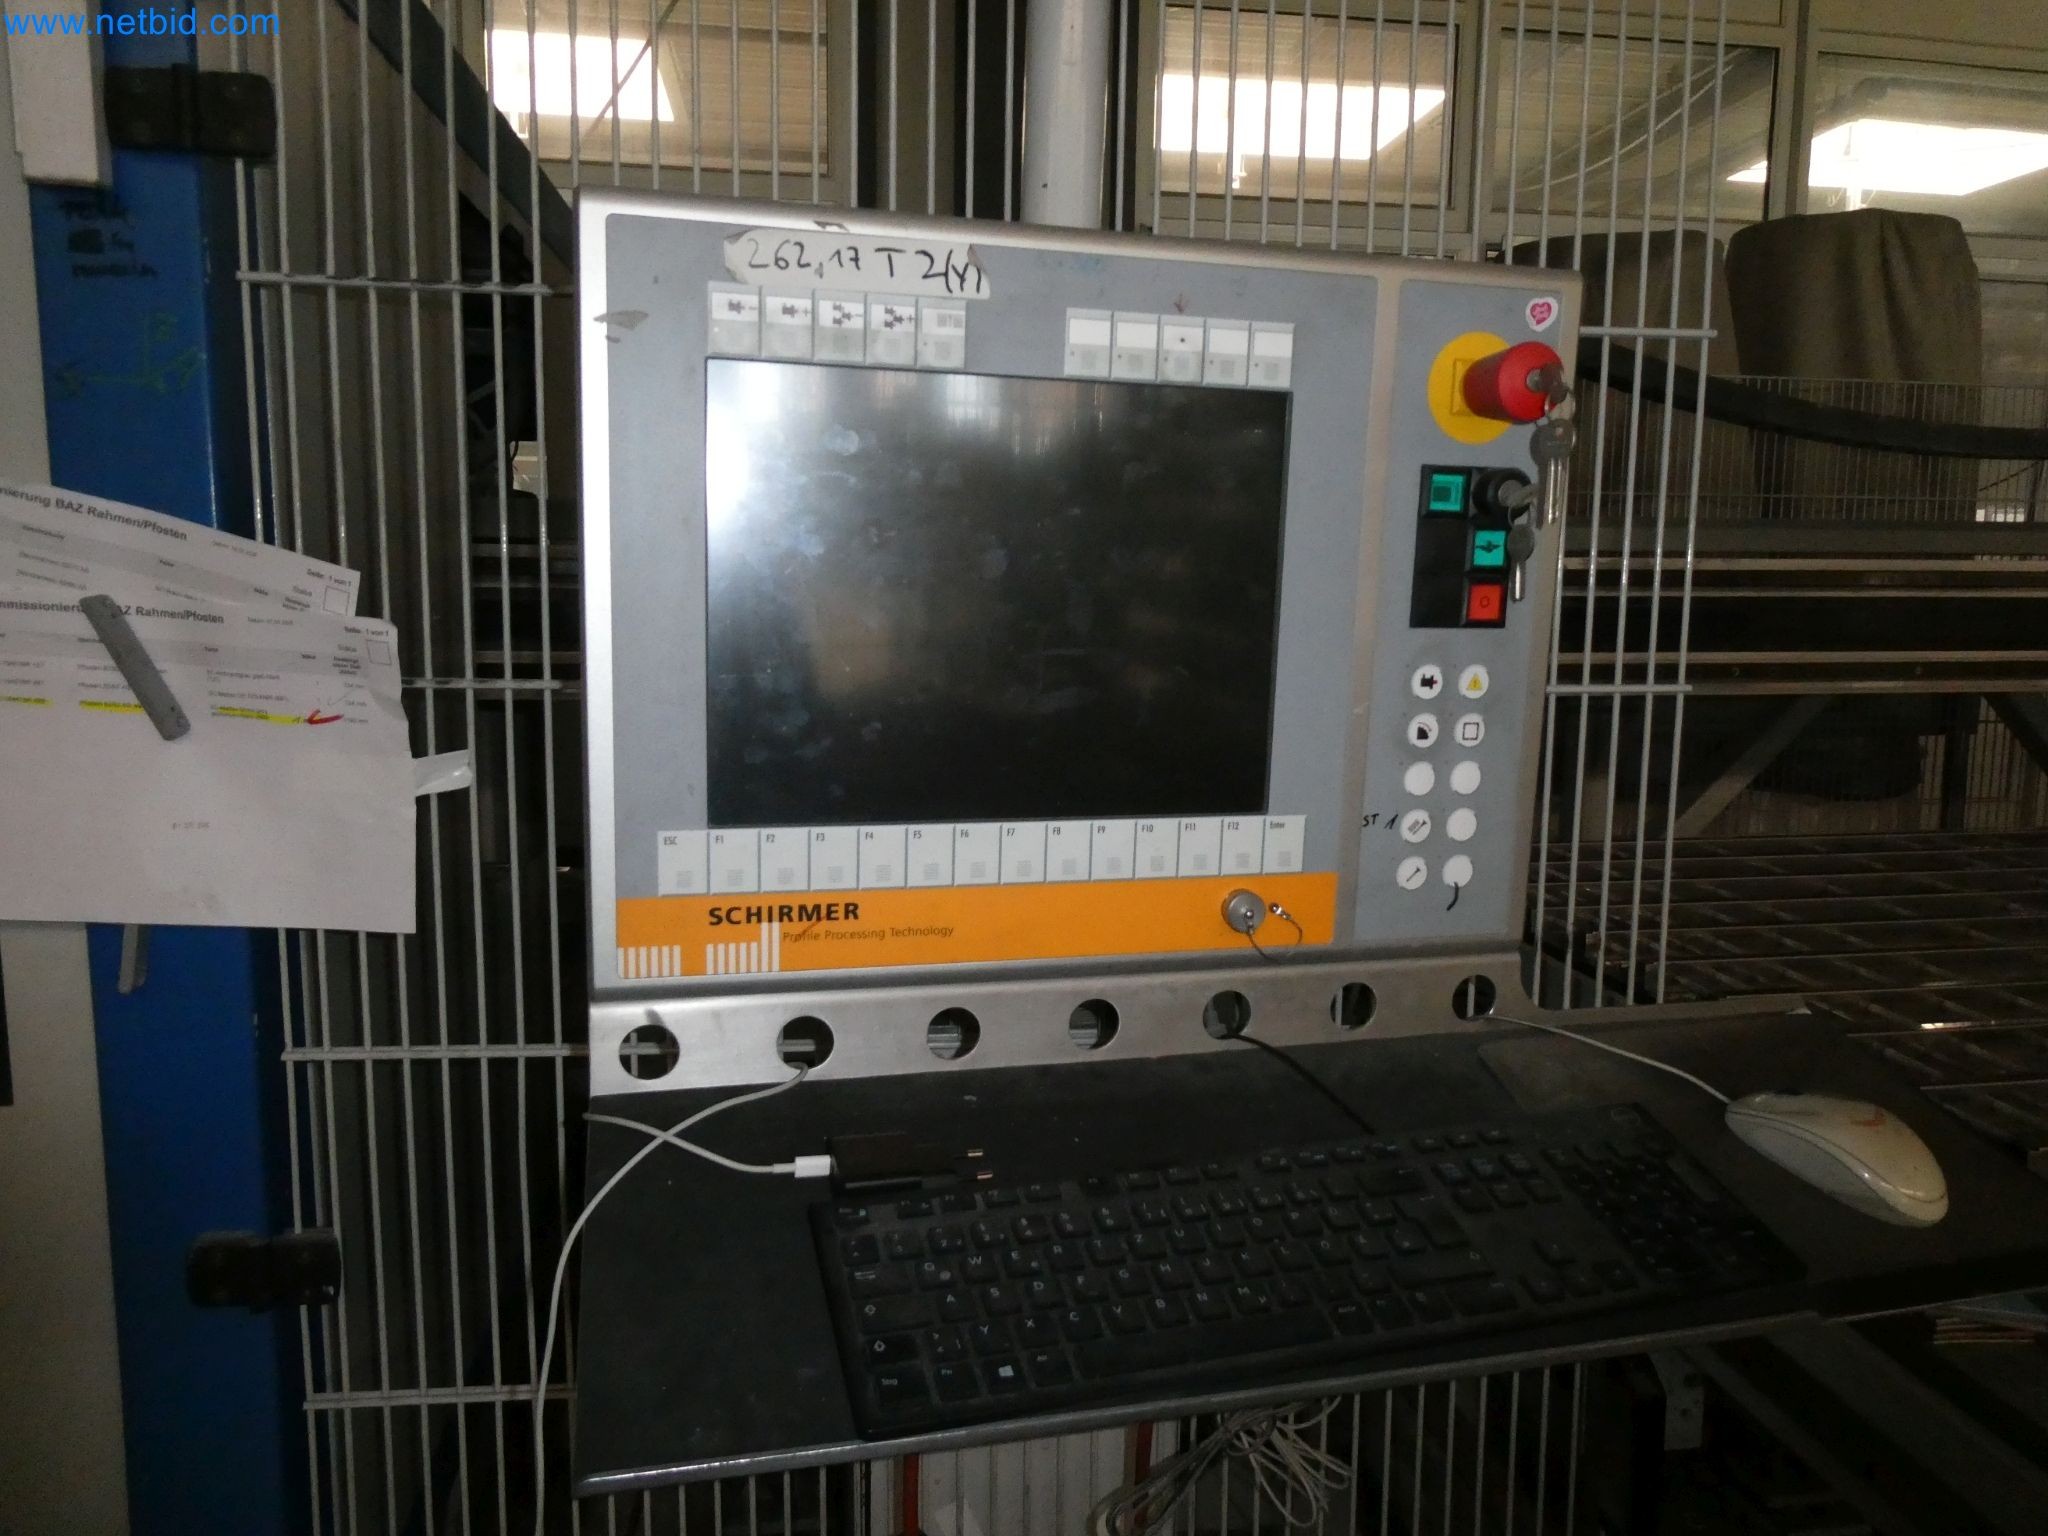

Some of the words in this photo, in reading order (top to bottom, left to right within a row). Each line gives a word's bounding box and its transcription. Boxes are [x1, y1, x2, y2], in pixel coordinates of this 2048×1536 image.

[875, 246, 906, 278] T
[55, 497, 84, 514] BAZ
[87, 504, 189, 542] Rahmen/Pfosten
[135, 606, 226, 624] Rahmen/Pfosten
[1097, 826, 1106, 834] F9
[1141, 824, 1154, 833] F10
[1185, 823, 1196, 831] F11
[1227, 822, 1240, 830] F12
[865, 831, 874, 840] F4
[913, 830, 922, 839] F5
[960, 829, 969, 838] F6
[1007, 828, 1016, 837] F7
[663, 836, 678, 846] ESC
[715, 835, 724, 845] F1
[766, 833, 775, 843] F2
[708, 902, 860, 926] SCHIRMER
[782, 930, 821, 943] Profile
[824, 927, 886, 941] Processing
[889, 925, 954, 939] Technology
